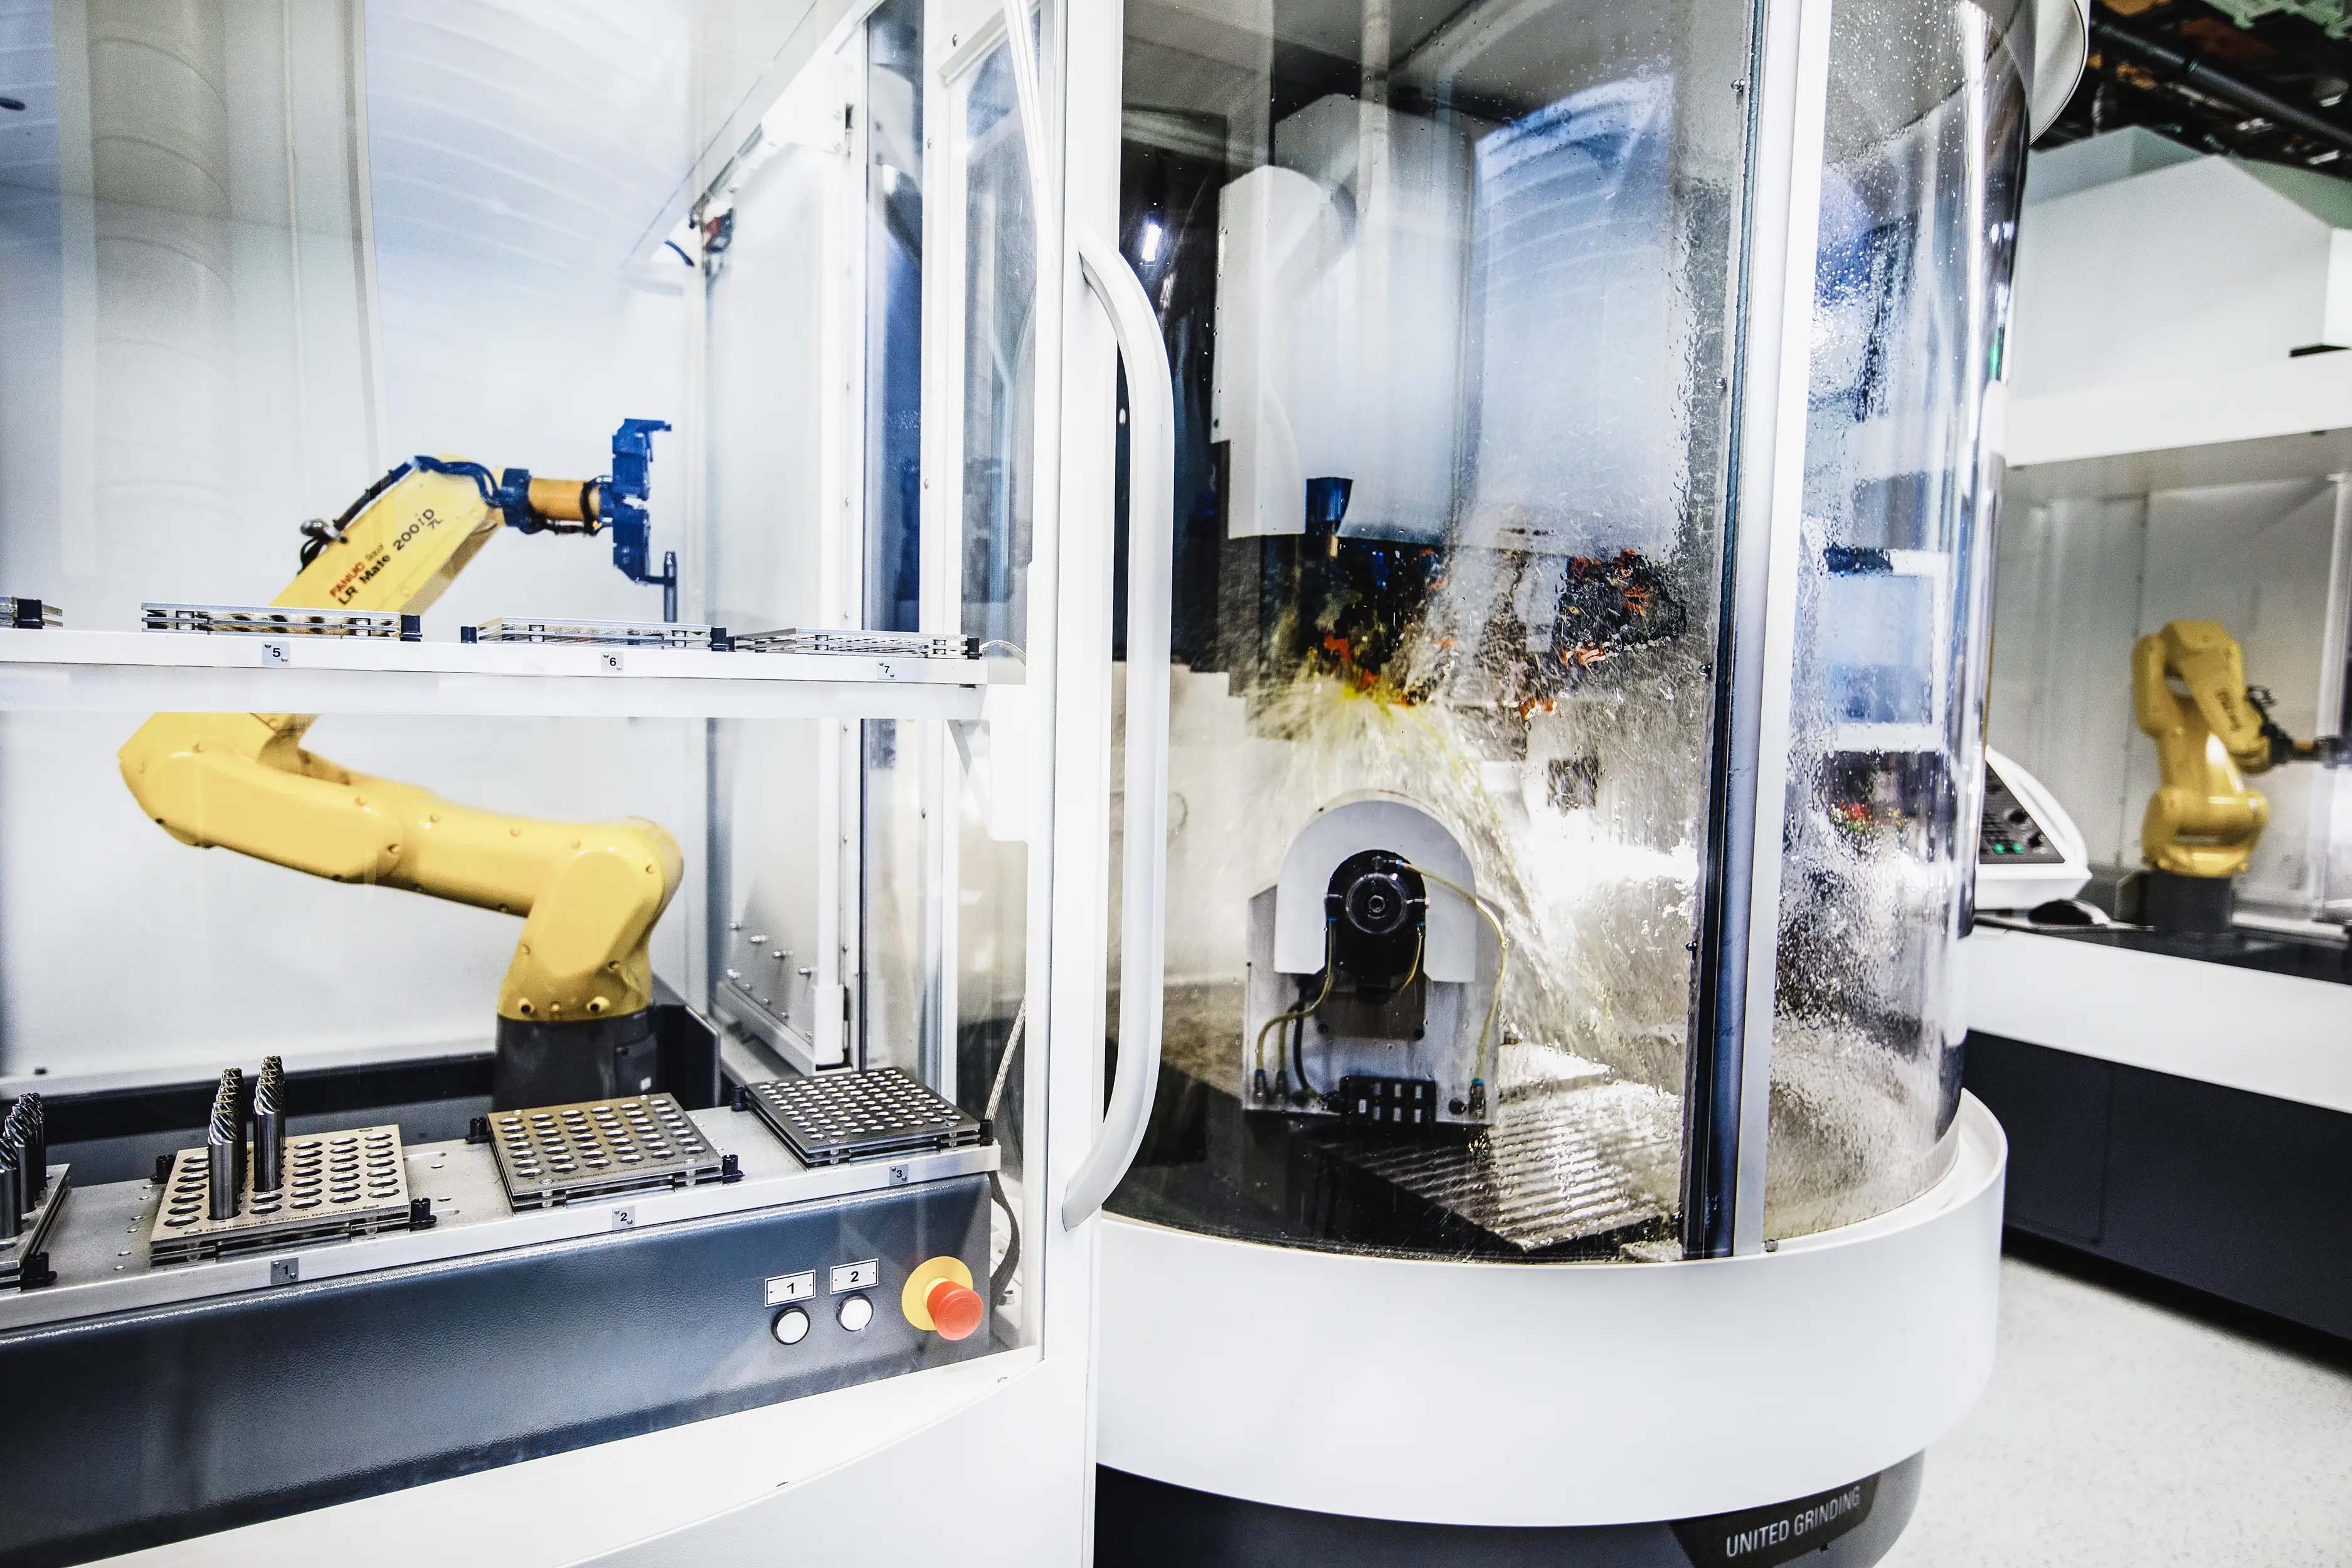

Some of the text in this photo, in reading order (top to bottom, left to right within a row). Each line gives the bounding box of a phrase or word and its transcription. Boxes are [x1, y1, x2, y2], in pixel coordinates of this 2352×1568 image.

[329, 562, 366, 597] FANUC
[338, 586, 358, 605] LR
[359, 554, 391, 585] Mate
[272, 647, 281, 658] 5
[610, 657, 617, 667] 6
[884, 665, 890, 674] 7
[896, 1169, 903, 1178] 3
[620, 1212, 627, 1222] 2
[283, 1265, 289, 1275] 1
[850, 1271, 859, 1283] 2
[787, 1283, 795, 1294] 1
[1726, 1485, 1861, 1557] UNITED GRINDING
